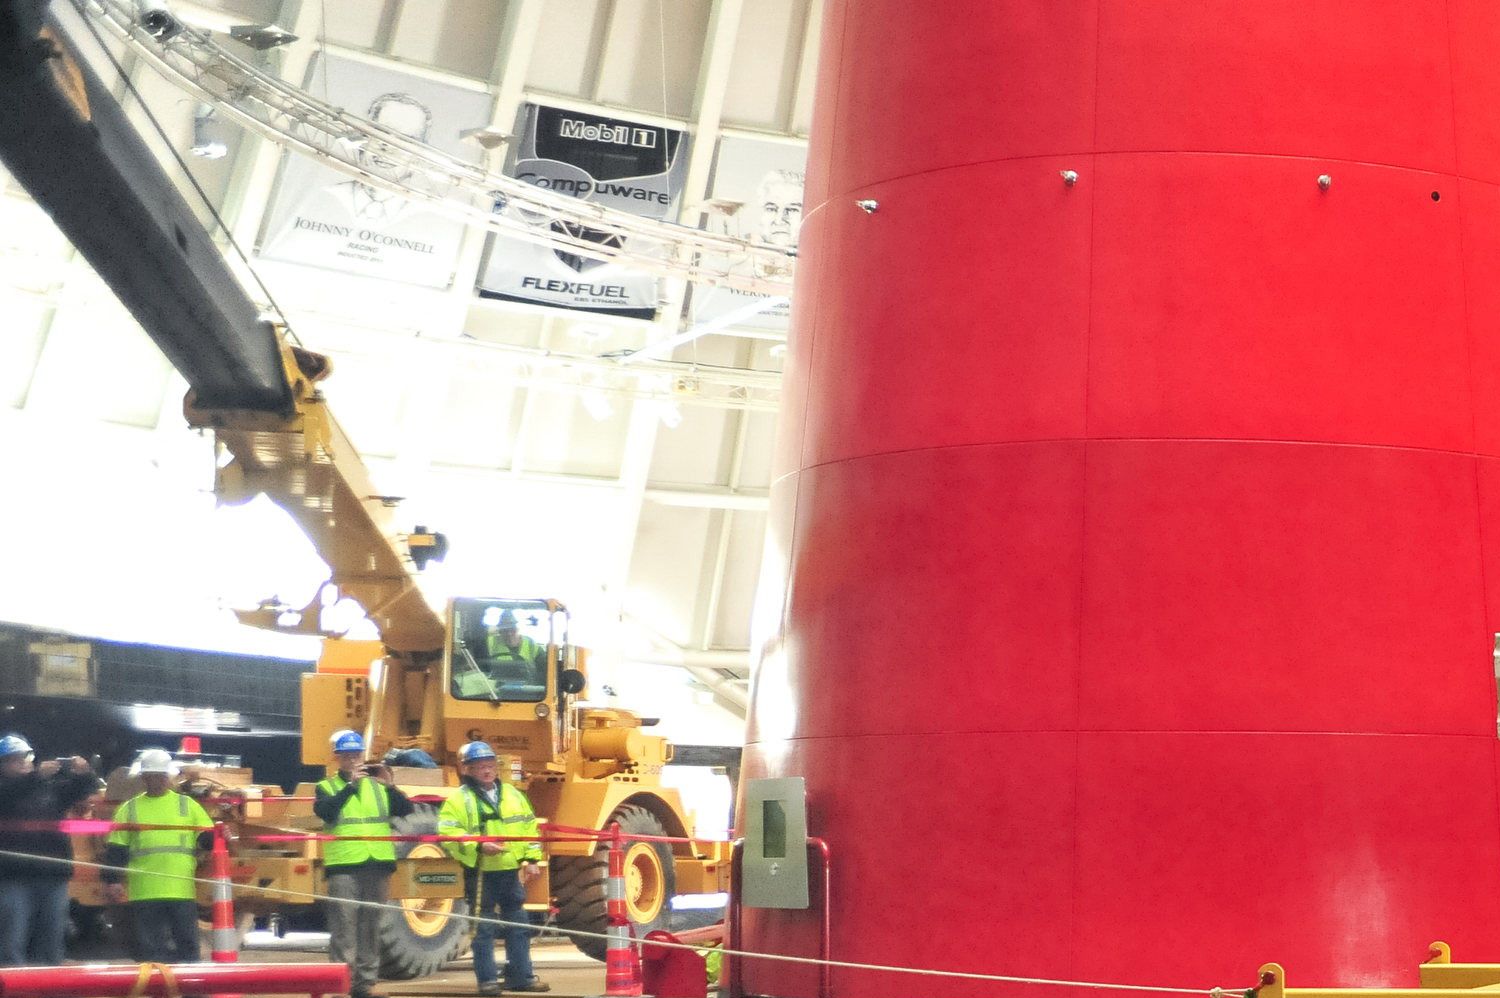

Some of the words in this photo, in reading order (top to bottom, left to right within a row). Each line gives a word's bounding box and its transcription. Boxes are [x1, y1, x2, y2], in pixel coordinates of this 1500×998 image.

[560, 118, 629, 145] Mobil
[294, 216, 352, 238] JOHNNY
[359, 229, 435, 254] O'CONNELL
[347, 242, 380, 254] RACING
[522, 276, 630, 298] FLEXFUEL
